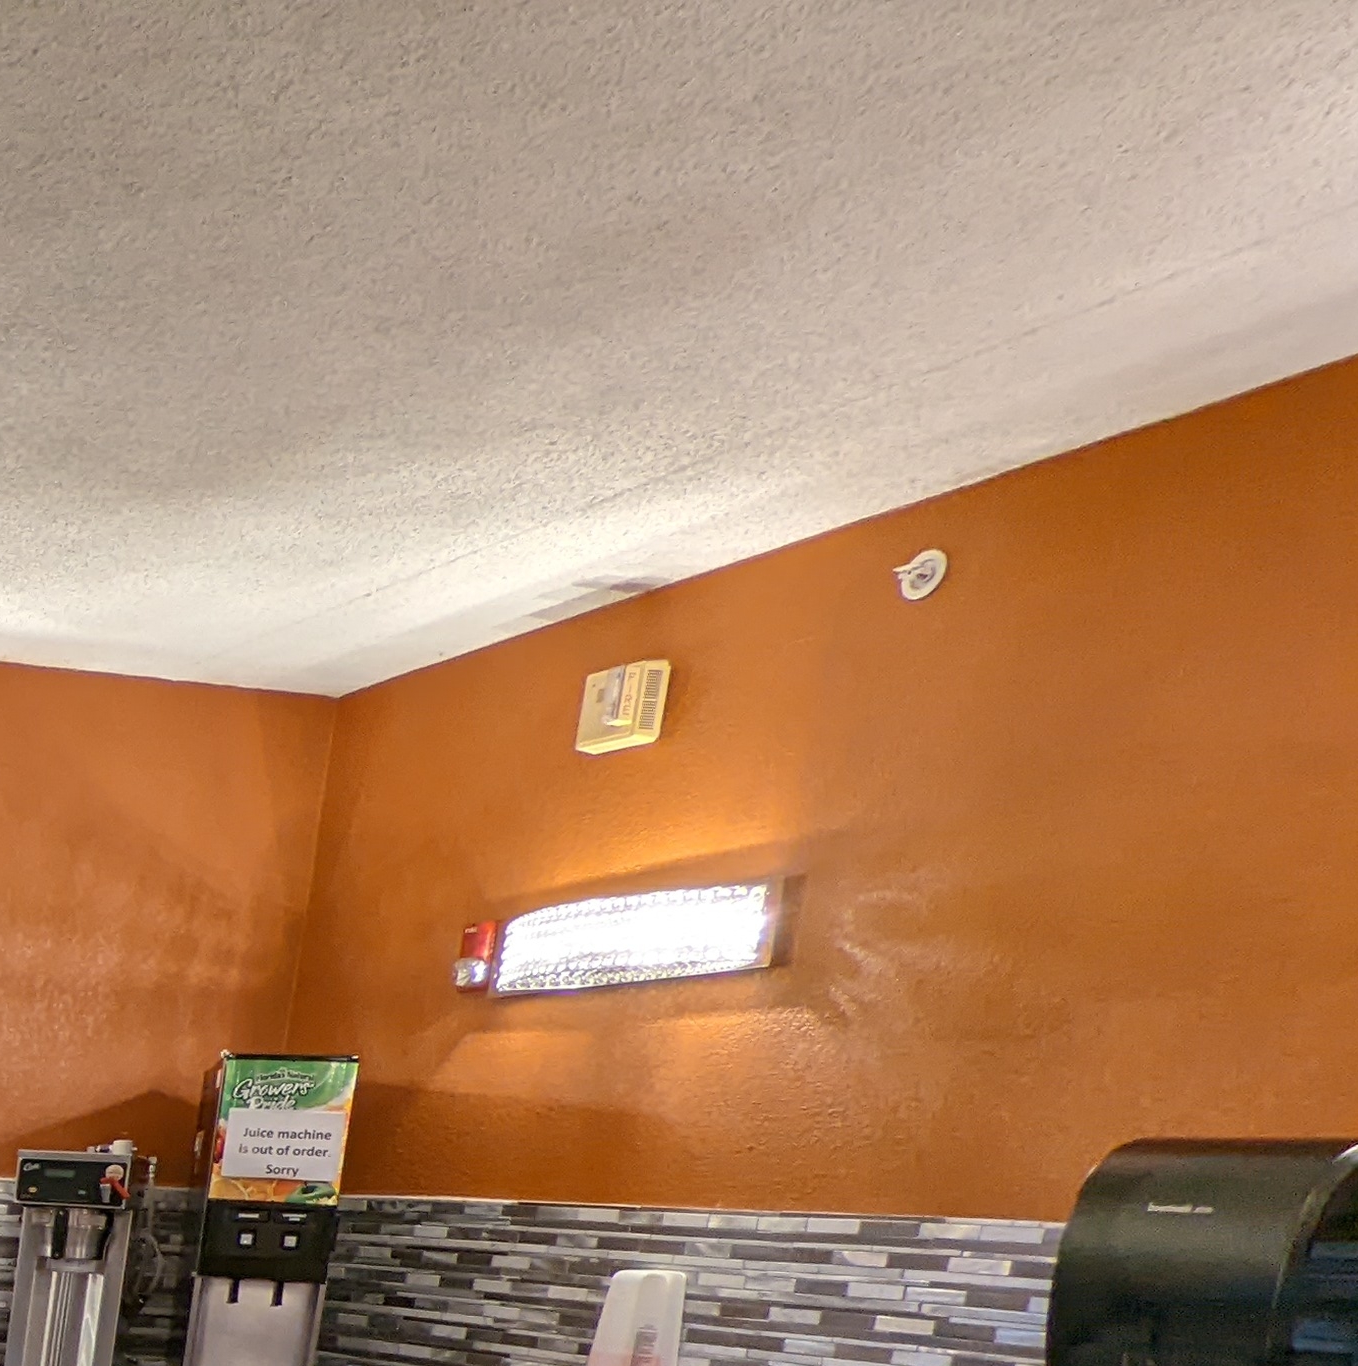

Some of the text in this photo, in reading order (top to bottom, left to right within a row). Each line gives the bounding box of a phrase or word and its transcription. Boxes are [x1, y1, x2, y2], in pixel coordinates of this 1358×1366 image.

[243, 1128, 332, 1140] Juice machine
[238, 1143, 332, 1158] is out of order.
[265, 1163, 300, 1177] Sorry
